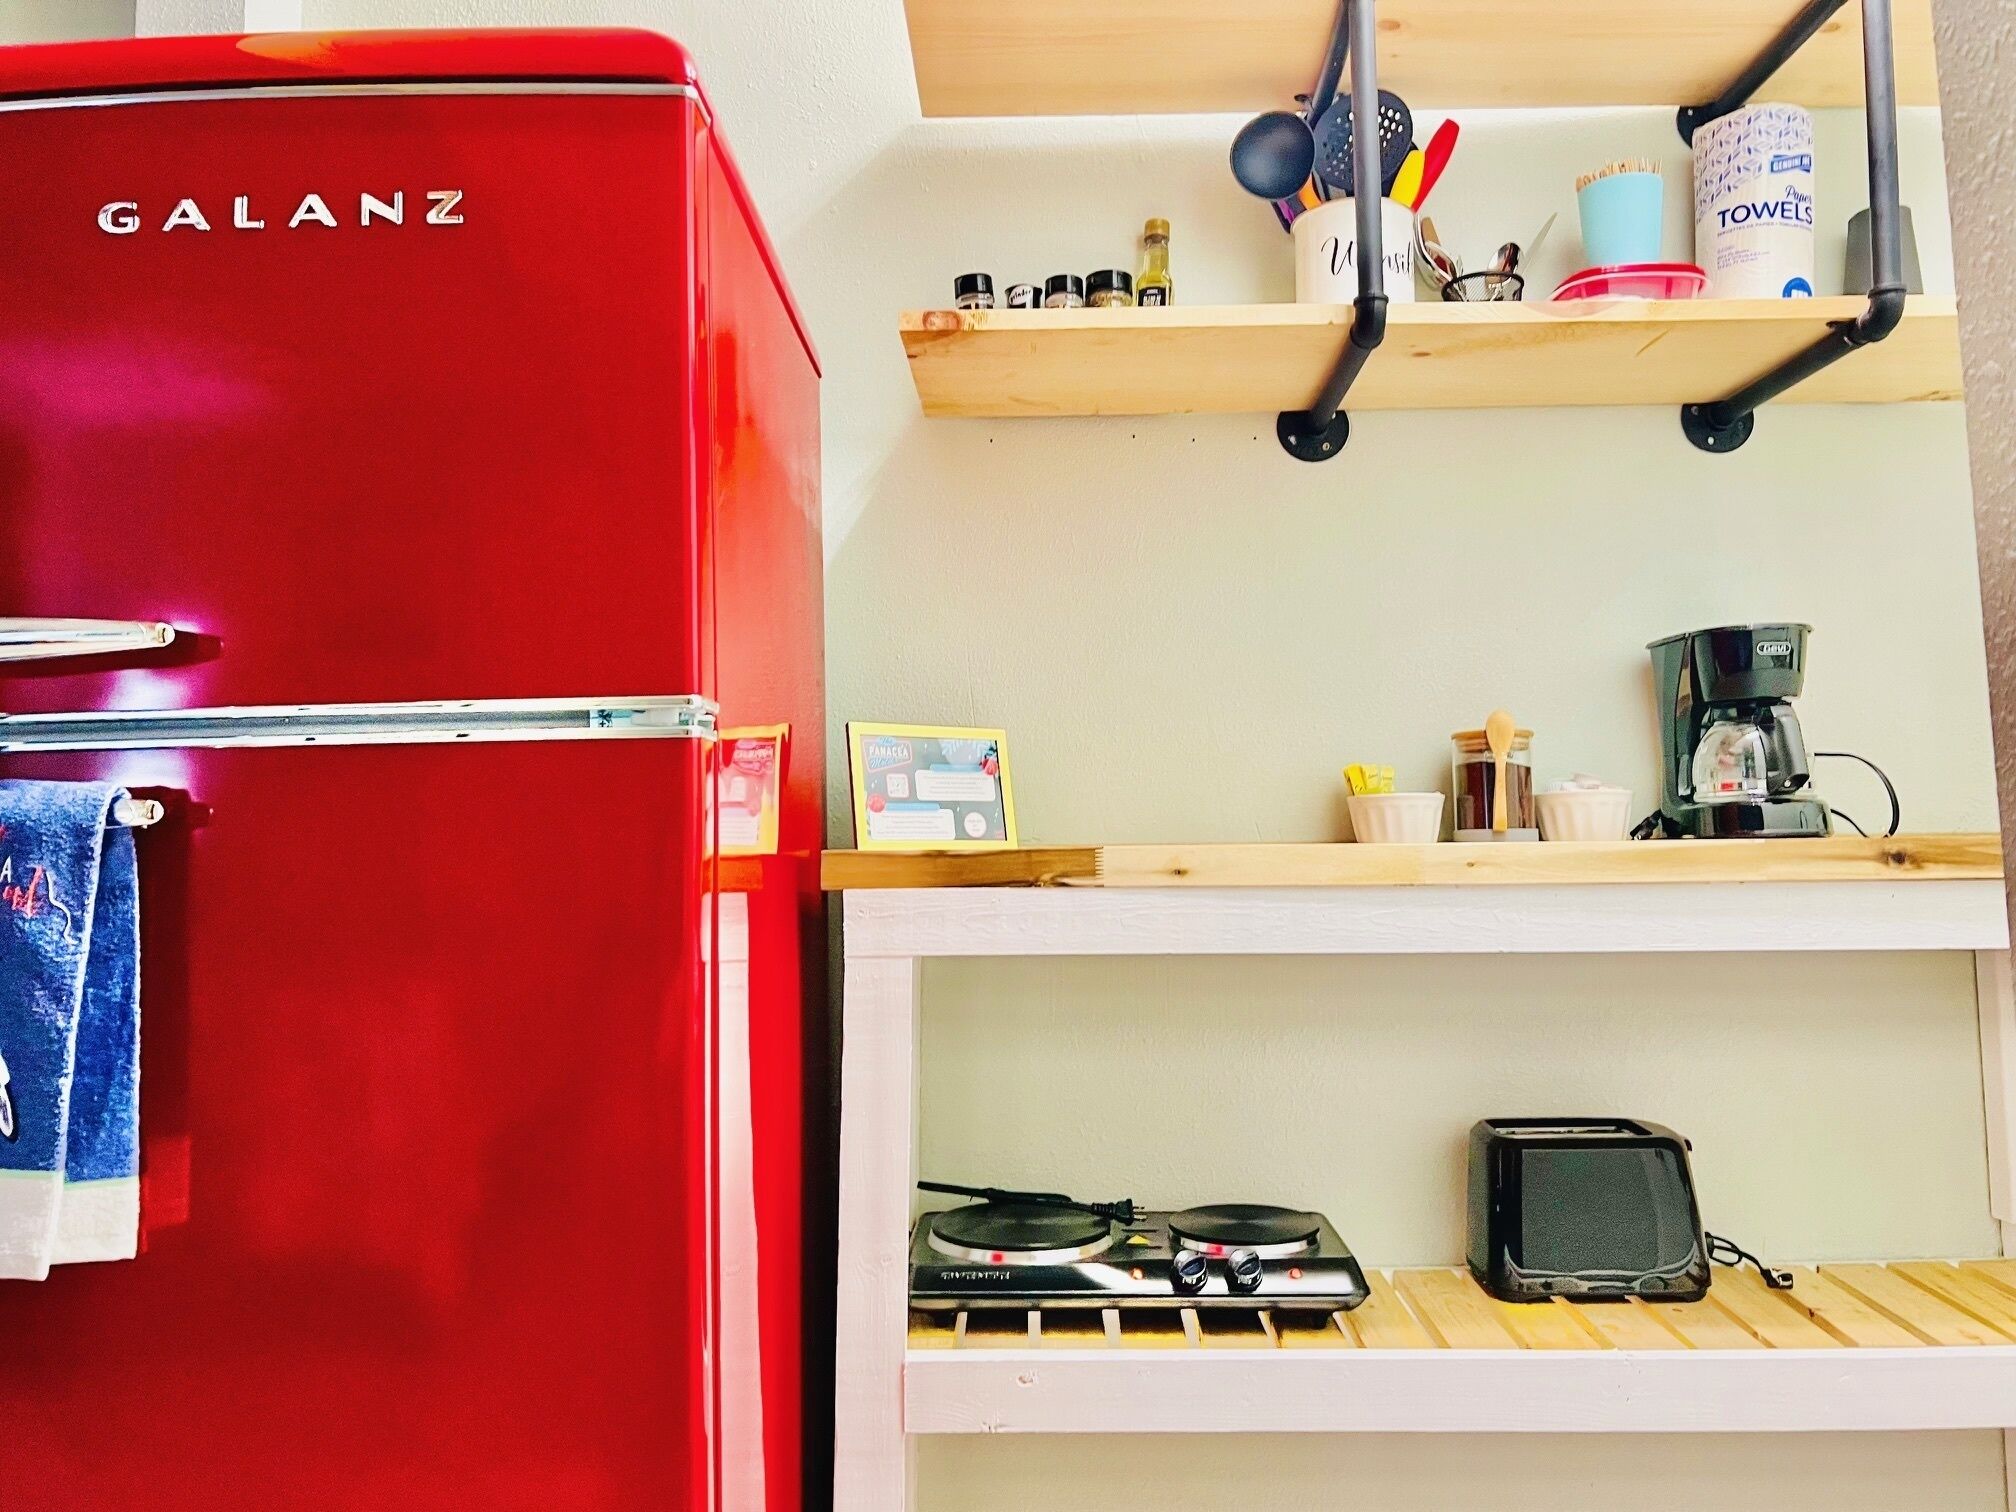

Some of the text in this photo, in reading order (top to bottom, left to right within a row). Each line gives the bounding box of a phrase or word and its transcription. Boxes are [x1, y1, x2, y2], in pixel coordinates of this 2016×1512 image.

[1785, 184, 1812, 205] Paper
[97, 189, 464, 234] GALANZ
[1717, 201, 1813, 229] TOWELS
